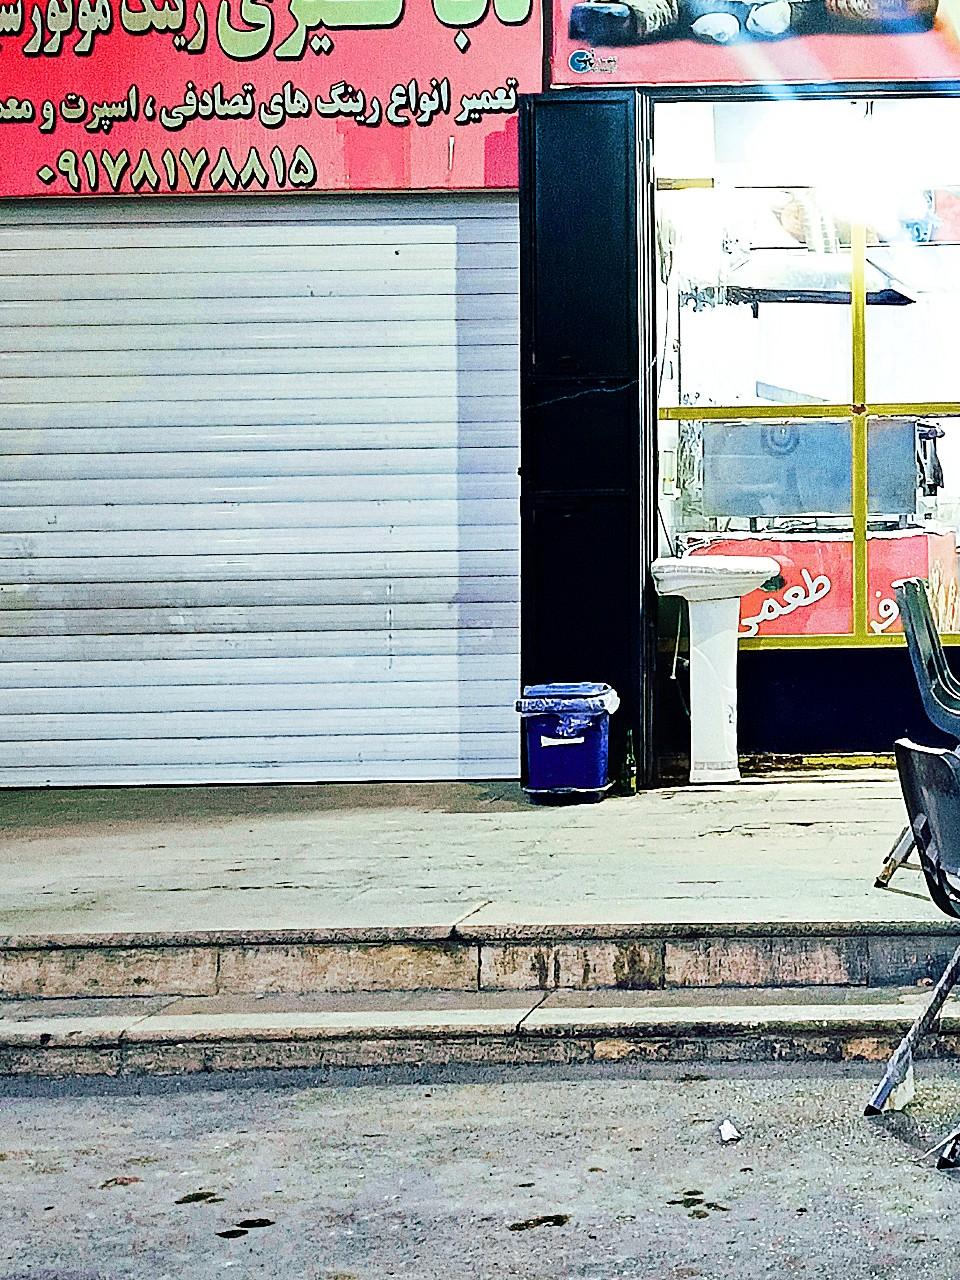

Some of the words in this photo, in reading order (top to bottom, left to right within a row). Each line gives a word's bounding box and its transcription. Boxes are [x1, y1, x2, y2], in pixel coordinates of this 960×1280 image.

[38, 98, 57, 135] و
[60, 83, 140, 135] اسپرت
[259, 80, 311, 130] های
[315, 80, 383, 127] رینگ
[386, 76, 451, 127] انواع
[454, 76, 520, 126] تعمیر
[37, 145, 318, 193] ۰۹۱۷۸۱۷۸۸۱۵
